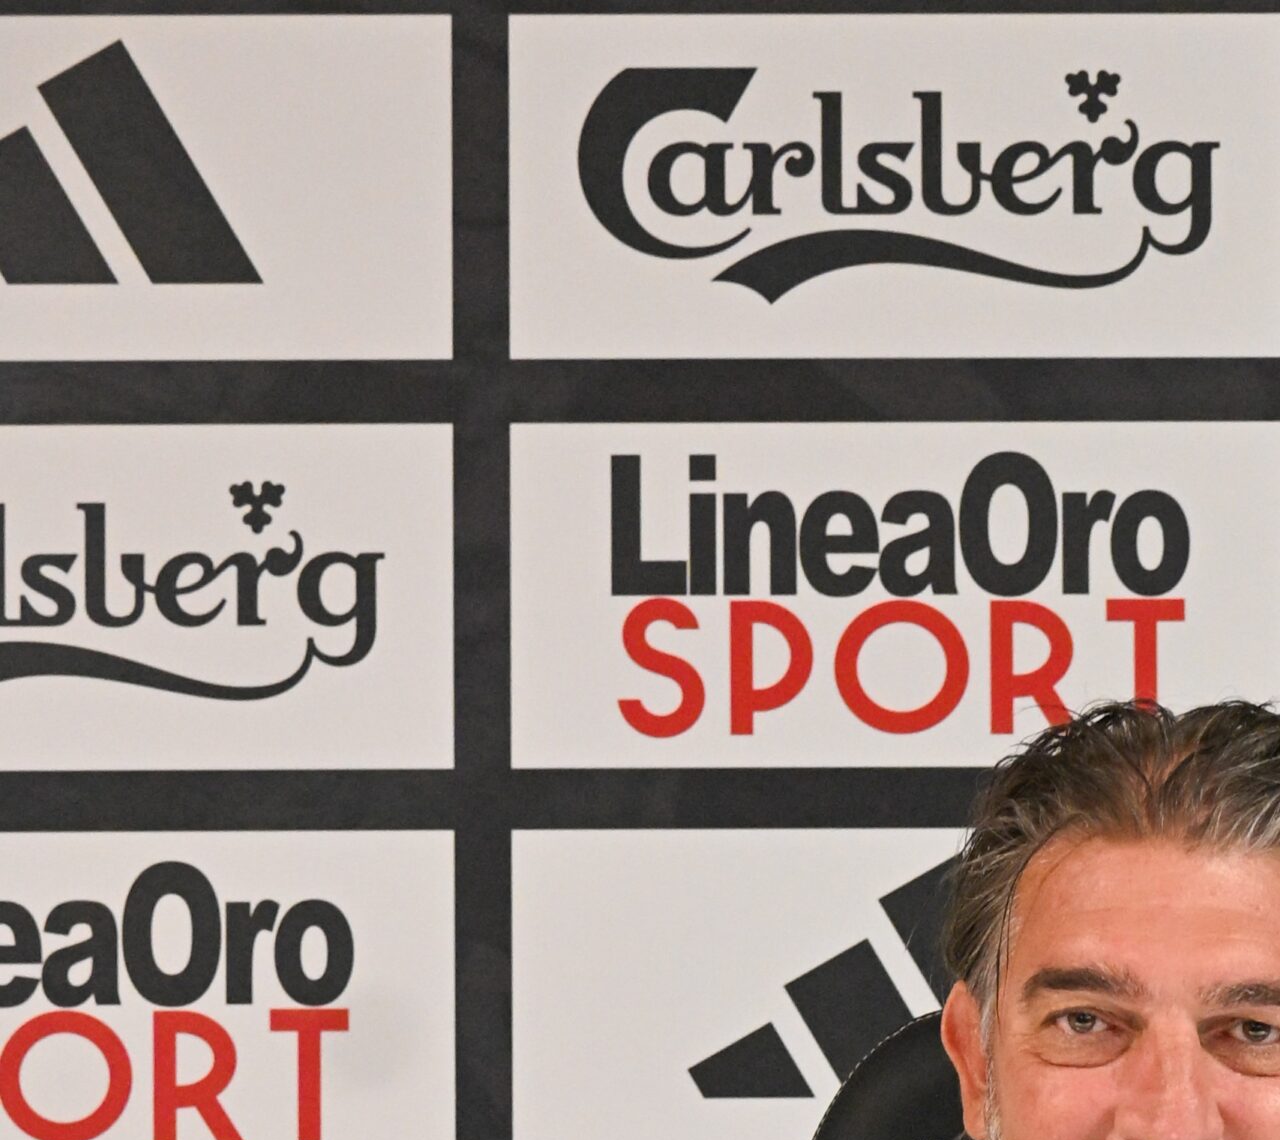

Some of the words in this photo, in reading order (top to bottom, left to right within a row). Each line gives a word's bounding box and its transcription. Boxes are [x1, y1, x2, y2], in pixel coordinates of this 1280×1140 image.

[578, 67, 1220, 260] Carlsberg
[0, 500, 385, 667] sberg
[611, 452, 1190, 597] LineaOro
[618, 598, 1185, 738] SPORT
